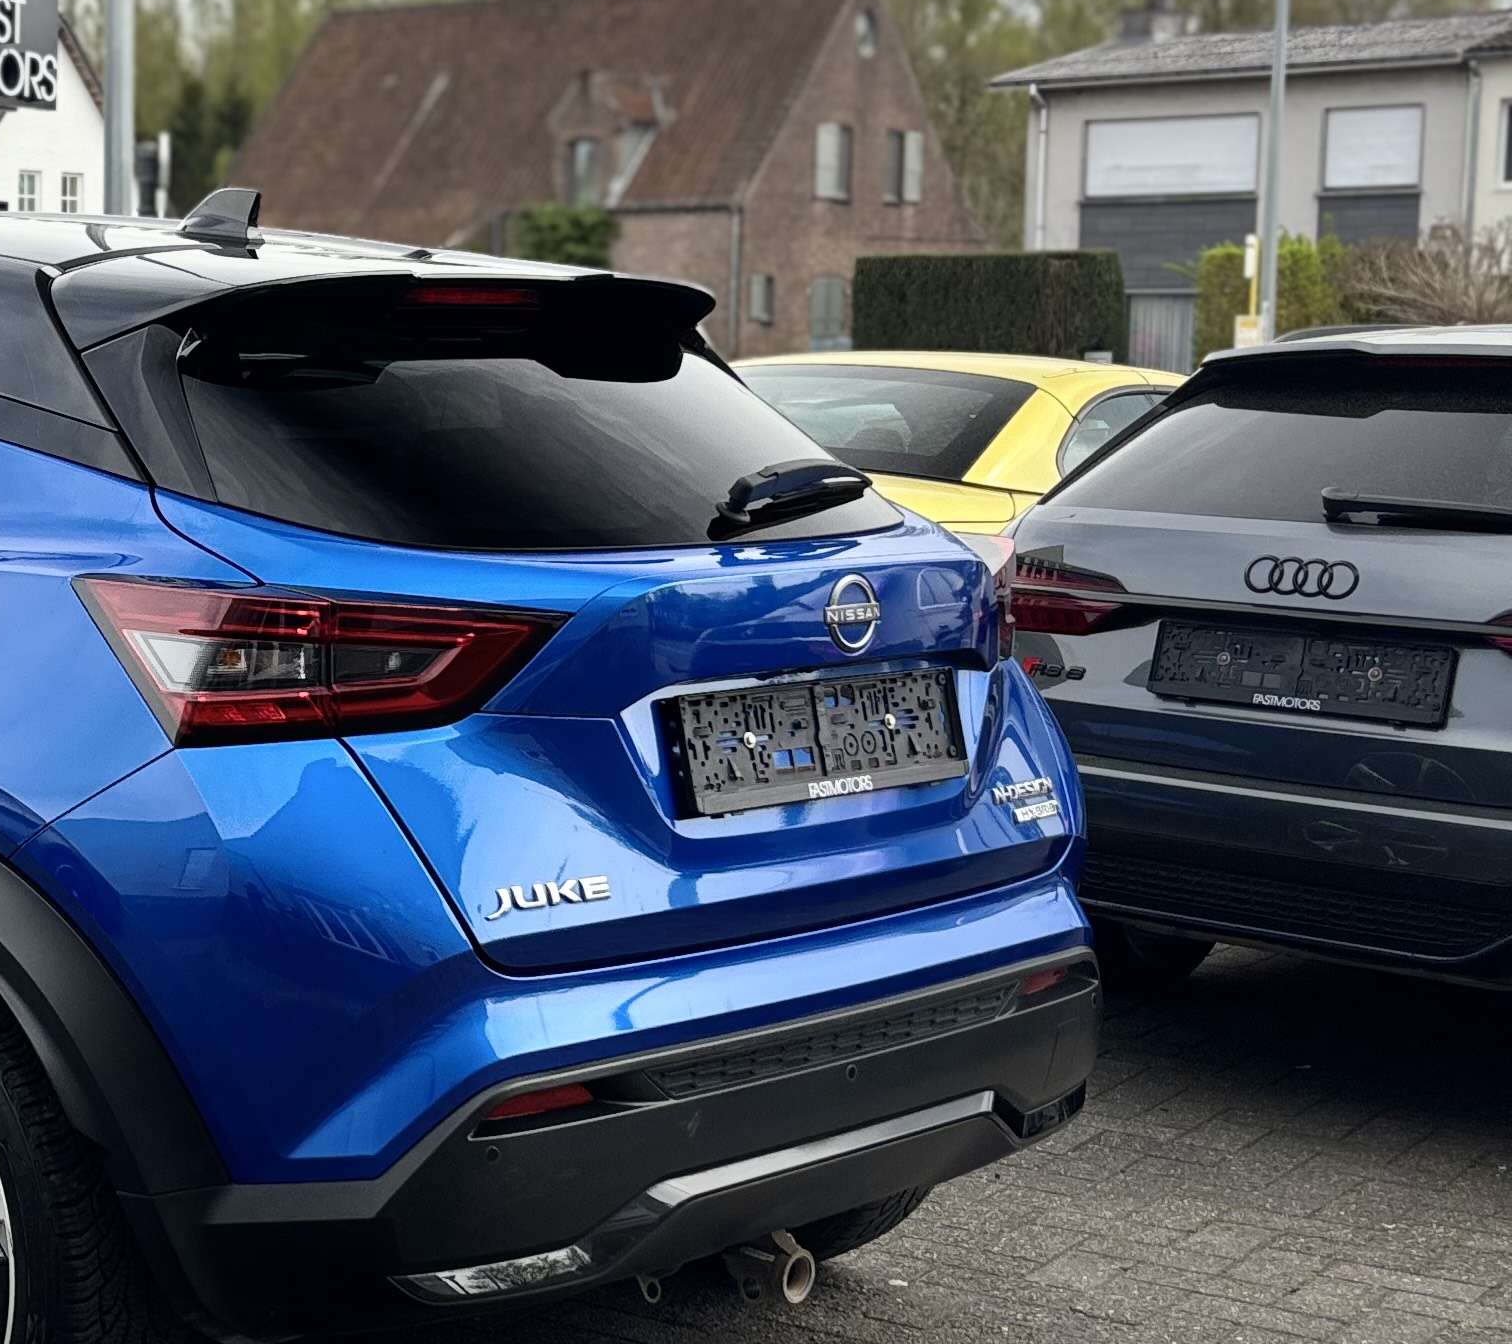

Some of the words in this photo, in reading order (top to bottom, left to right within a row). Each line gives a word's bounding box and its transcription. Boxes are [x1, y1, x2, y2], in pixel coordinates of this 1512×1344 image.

[826, 607, 881, 623] NISSAN
[991, 776, 1053, 806] N-DESIGN
[483, 874, 612, 922] JUKE
